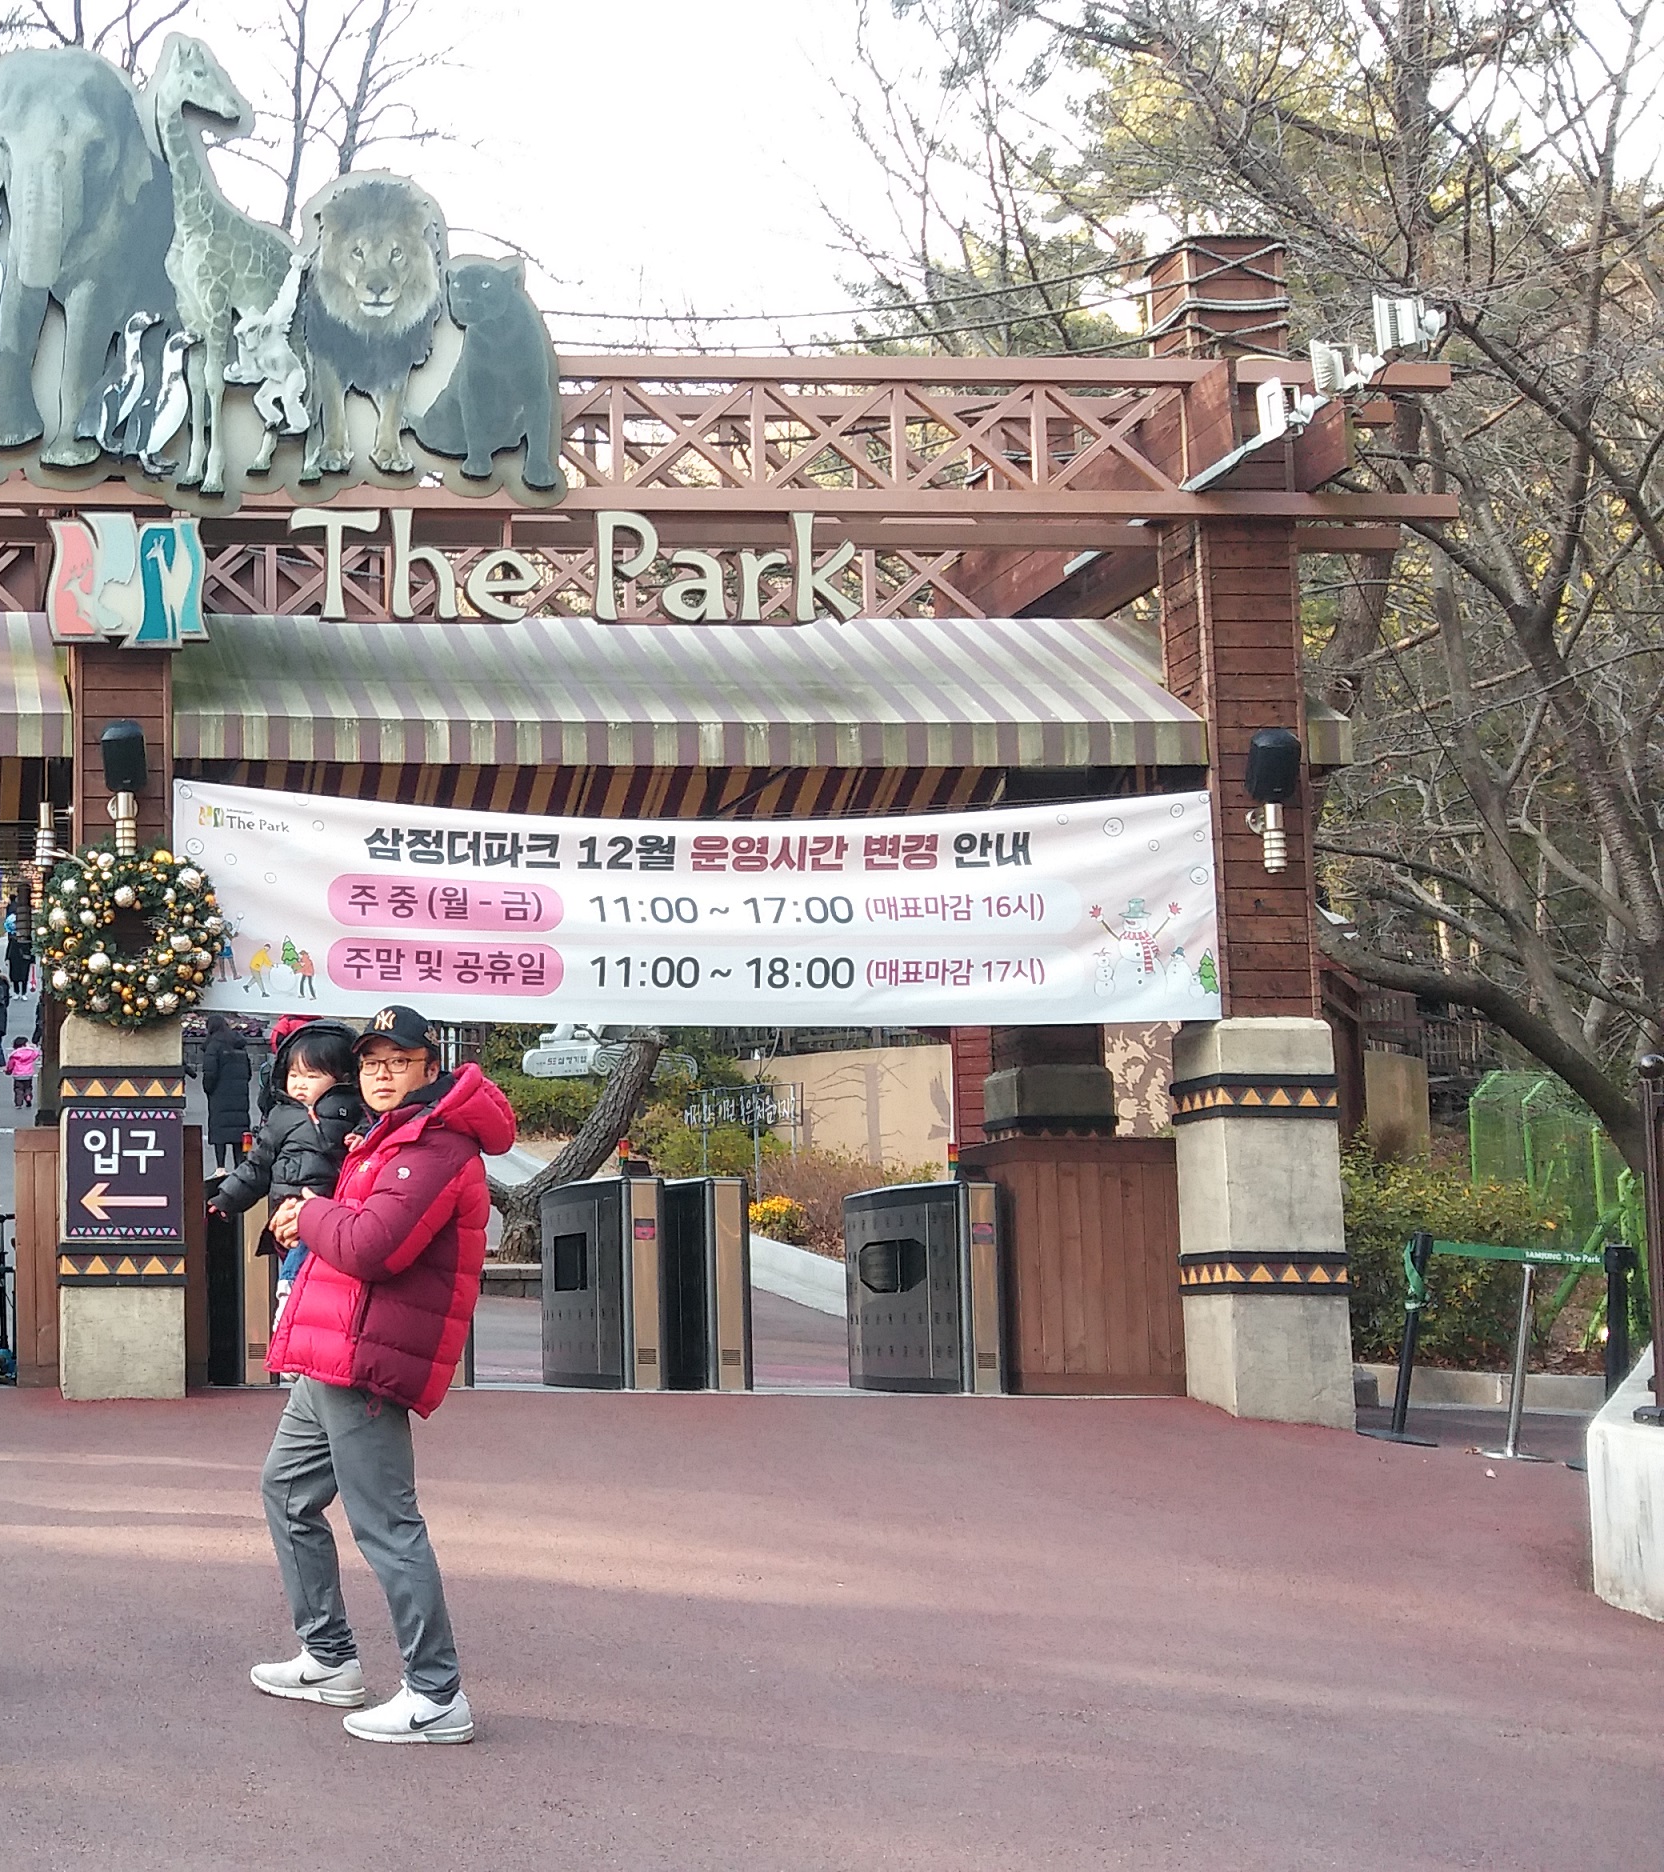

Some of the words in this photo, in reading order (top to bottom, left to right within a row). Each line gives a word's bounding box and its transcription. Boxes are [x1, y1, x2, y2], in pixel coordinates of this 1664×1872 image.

[287, 506, 541, 622] The
[592, 508, 865, 625] Park
[225, 815, 255, 831] The
[259, 818, 290, 833] Park
[363, 826, 561, 870] 삼정더파크
[576, 834, 677, 872] 12월
[689, 834, 849, 873] 운영시간
[863, 833, 939, 873] 변경
[952, 829, 1033, 869] 안내
[589, 895, 699, 924] 11:00
[742, 895, 854, 925] 17:00
[865, 893, 974, 924] (매표마감
[981, 892, 1046, 923] 16시)
[343, 946, 406, 982] 주말
[414, 949, 444, 984] 및
[451, 950, 546, 987] 공휴일
[589, 955, 700, 989] 11:00
[745, 956, 855, 990] 18:00
[866, 956, 974, 988] (매표마감
[981, 956, 1047, 987] 17시)
[83, 1127, 165, 1175] 입구
[1525, 1251, 1562, 1260] SAMJUNG
[1564, 1253, 1581, 1262] The
[1583, 1254, 1601, 1263] Park
